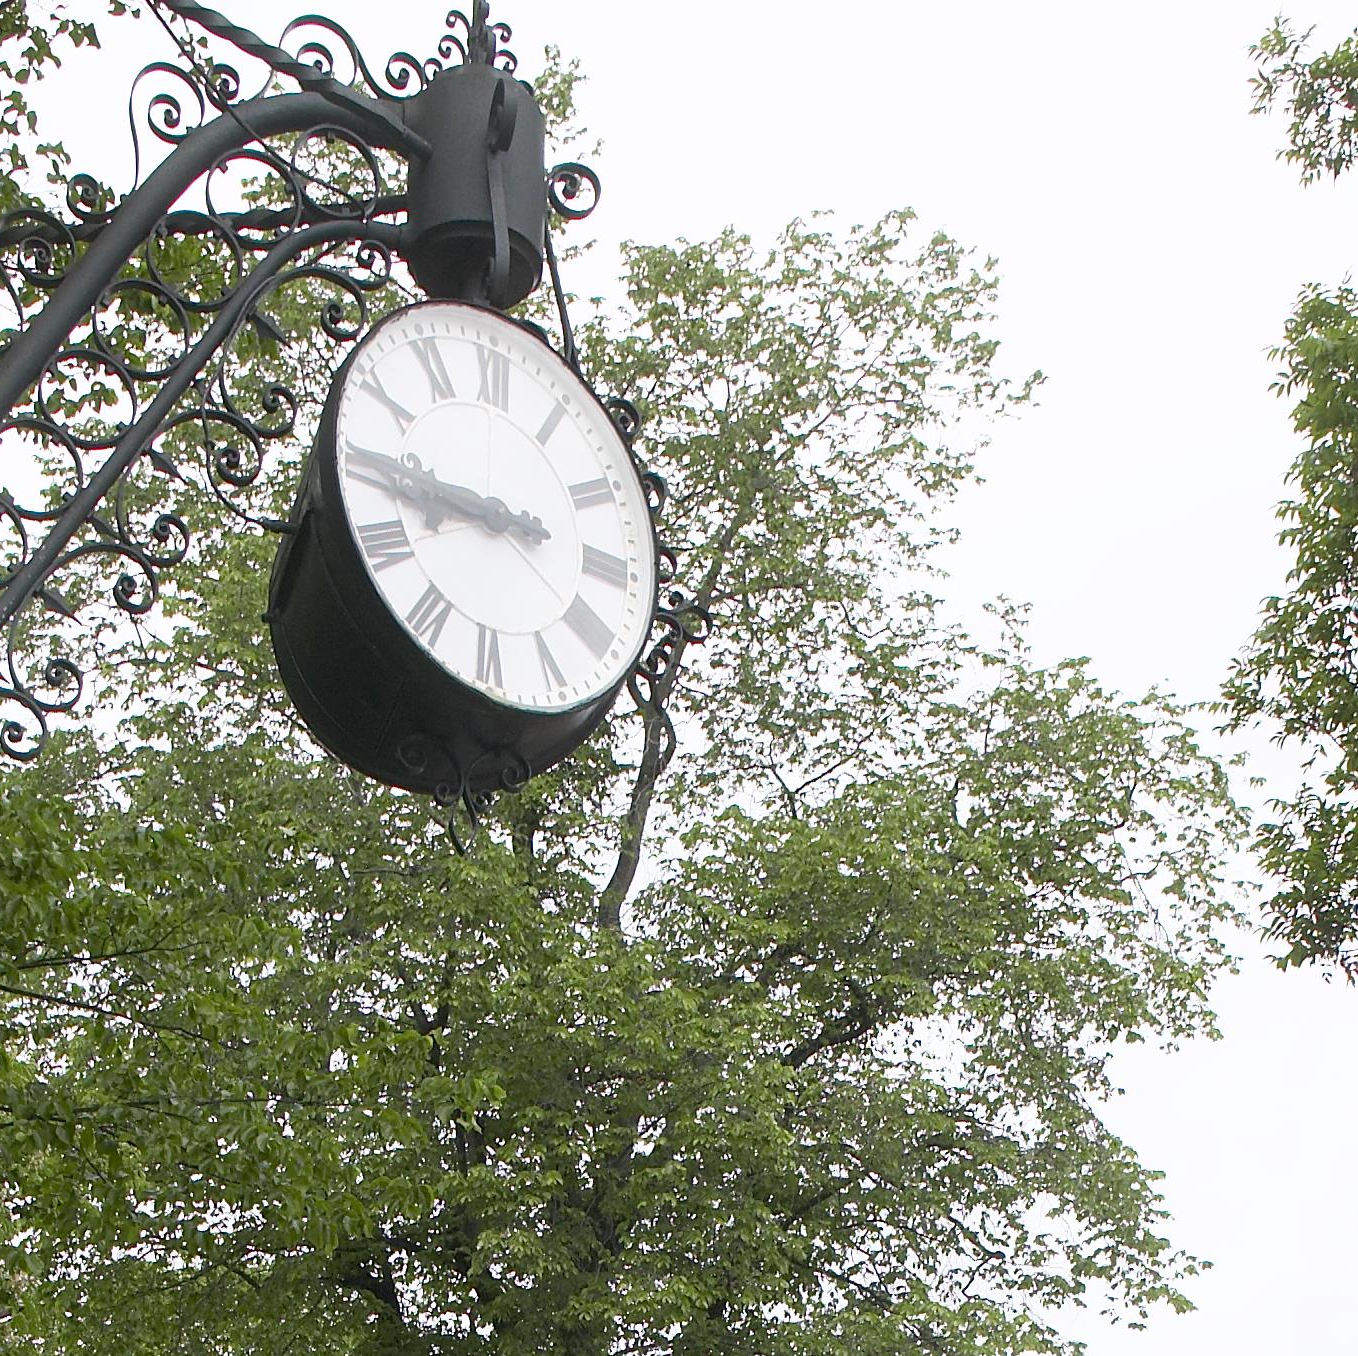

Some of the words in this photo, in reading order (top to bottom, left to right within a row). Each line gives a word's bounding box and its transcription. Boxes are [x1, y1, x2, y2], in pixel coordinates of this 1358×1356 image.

[473, 341, 511, 413] XII
[535, 399, 567, 446] I
[567, 474, 616, 511] II
[356, 519, 416, 573] VIII
[581, 542, 628, 592] III
[405, 579, 454, 650] VII
[475, 622, 504, 689] VI
[532, 630, 567, 692] V
